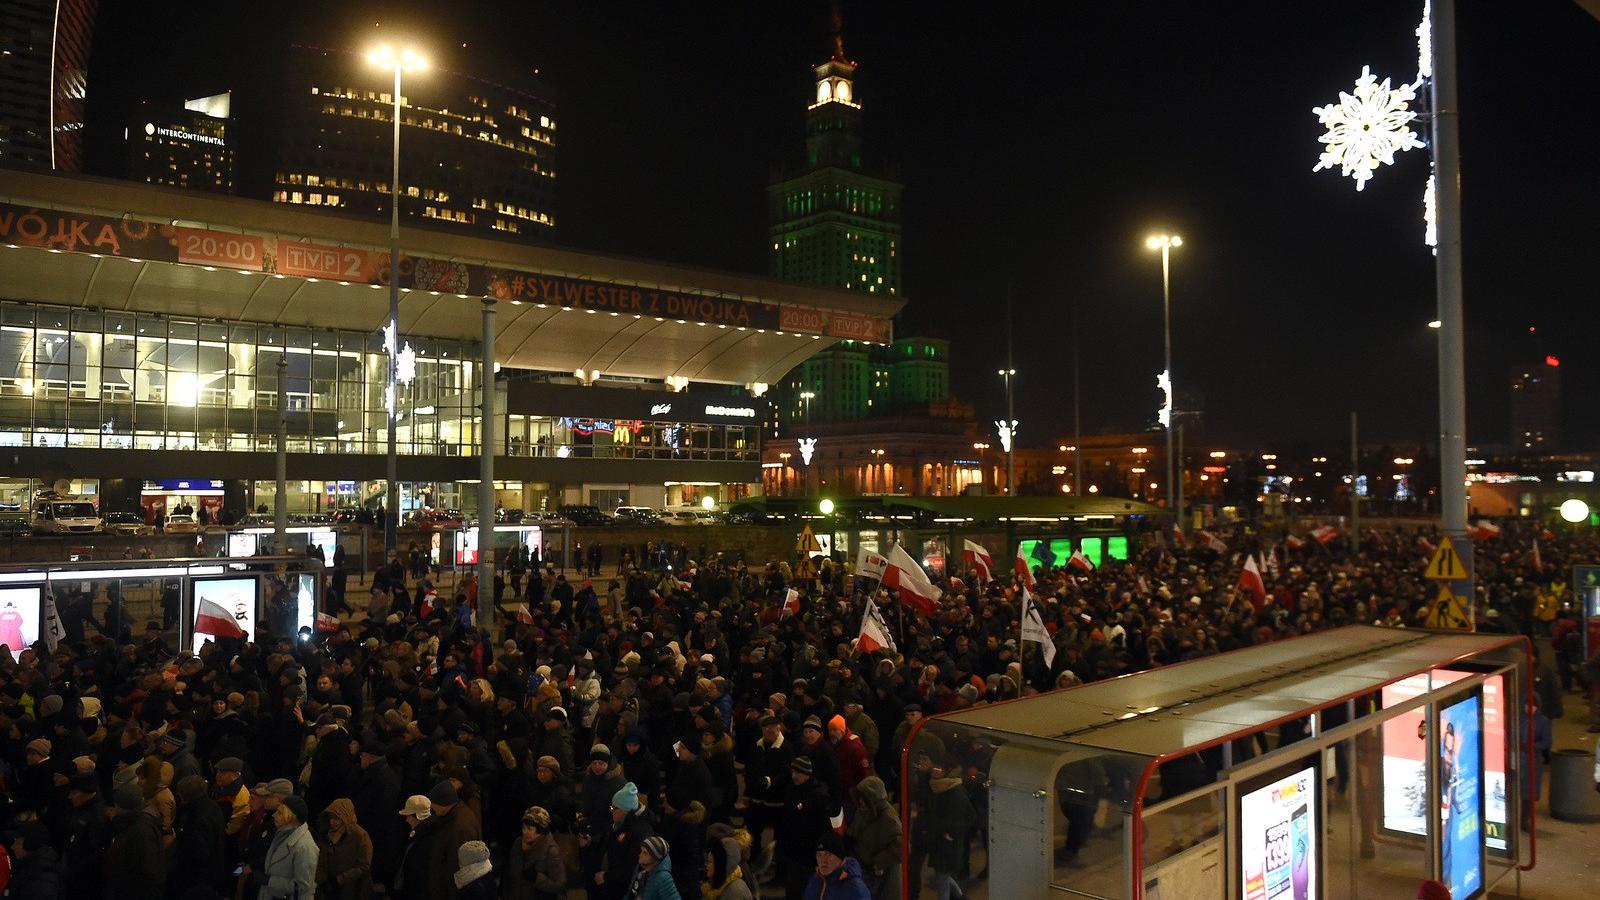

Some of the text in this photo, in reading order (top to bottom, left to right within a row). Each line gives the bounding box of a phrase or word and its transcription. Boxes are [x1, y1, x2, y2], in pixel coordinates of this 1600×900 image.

[186, 235, 256, 261] 20:00
[288, 249, 361, 276] TVP 2
[511, 275, 641, 309] #SYLWESTER
[783, 311, 819, 328] 20:00
[834, 318, 873, 336] TVP 2
